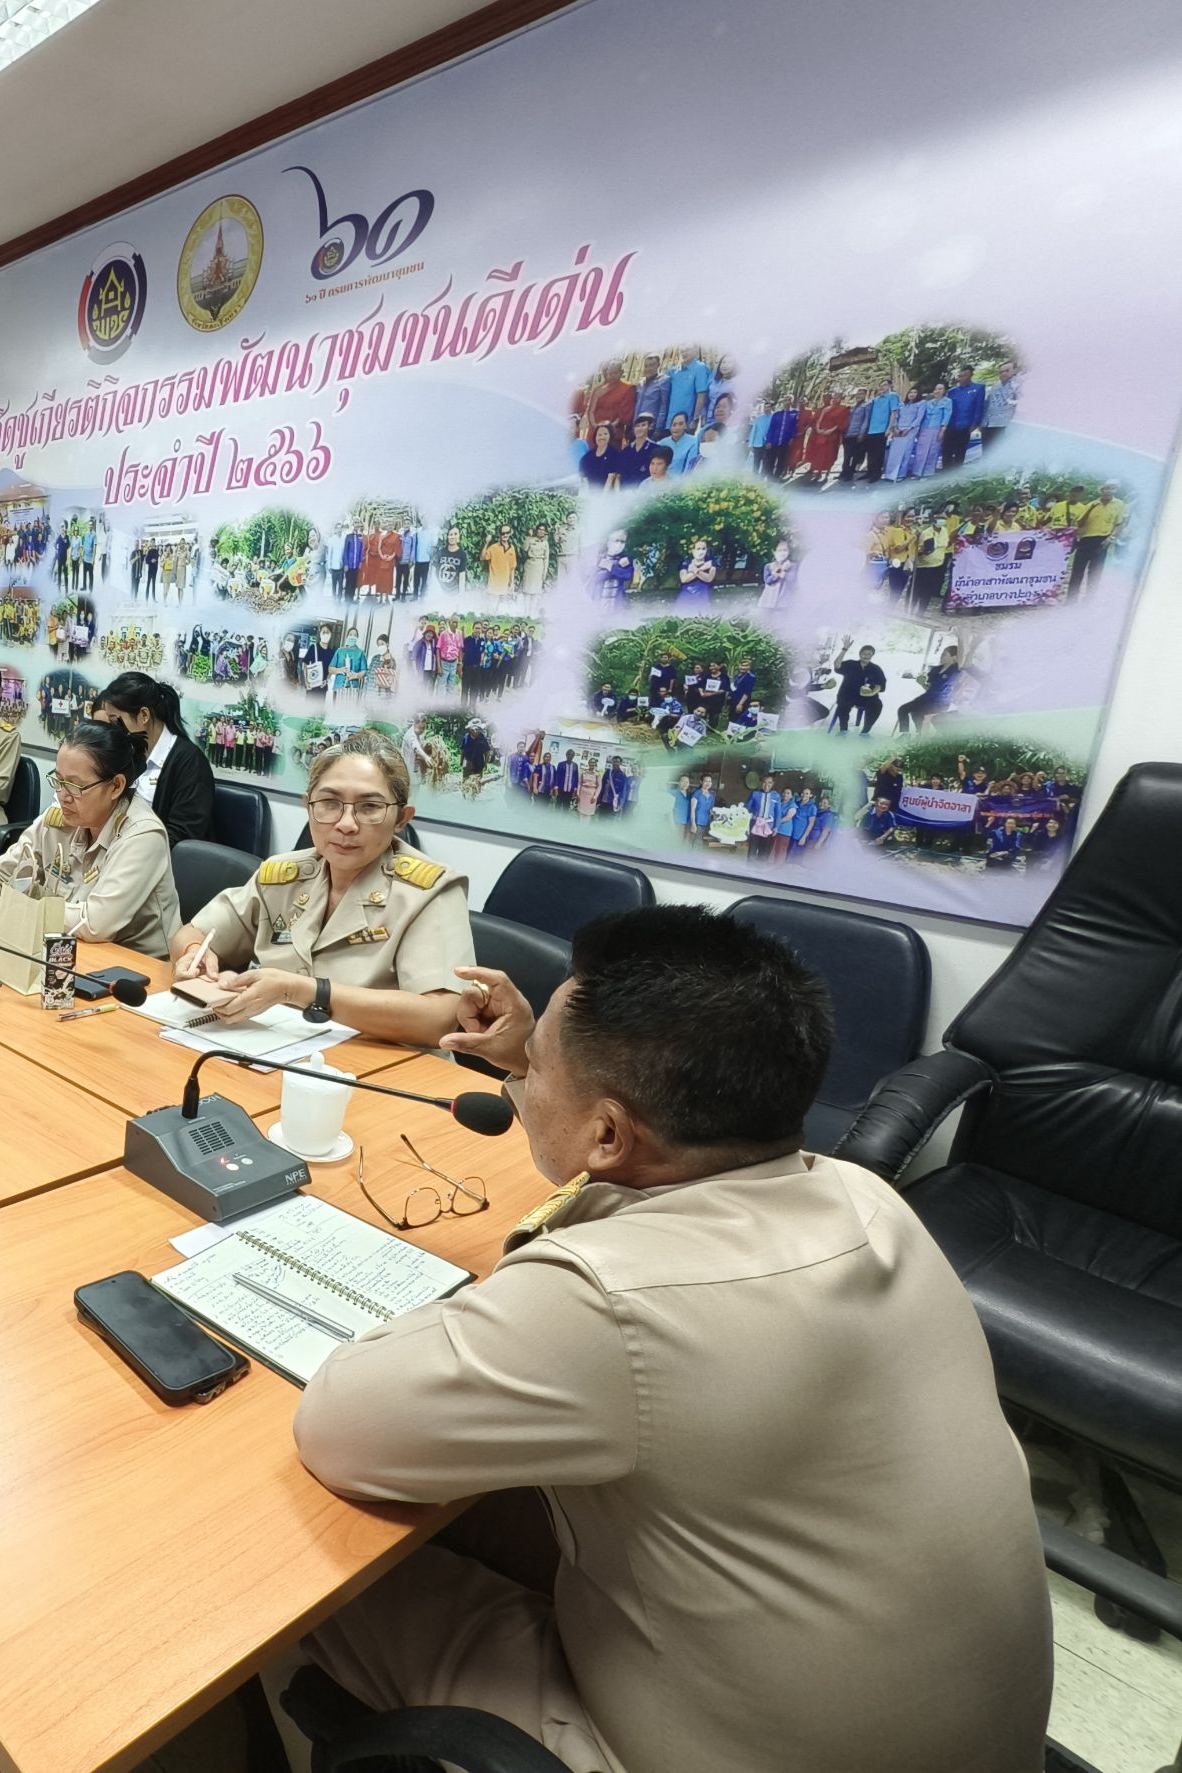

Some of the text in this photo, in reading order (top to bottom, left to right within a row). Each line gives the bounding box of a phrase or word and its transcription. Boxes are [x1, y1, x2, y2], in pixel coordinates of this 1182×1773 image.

[104, 420, 332, 505] ประจำปี ๒๕๖๖
